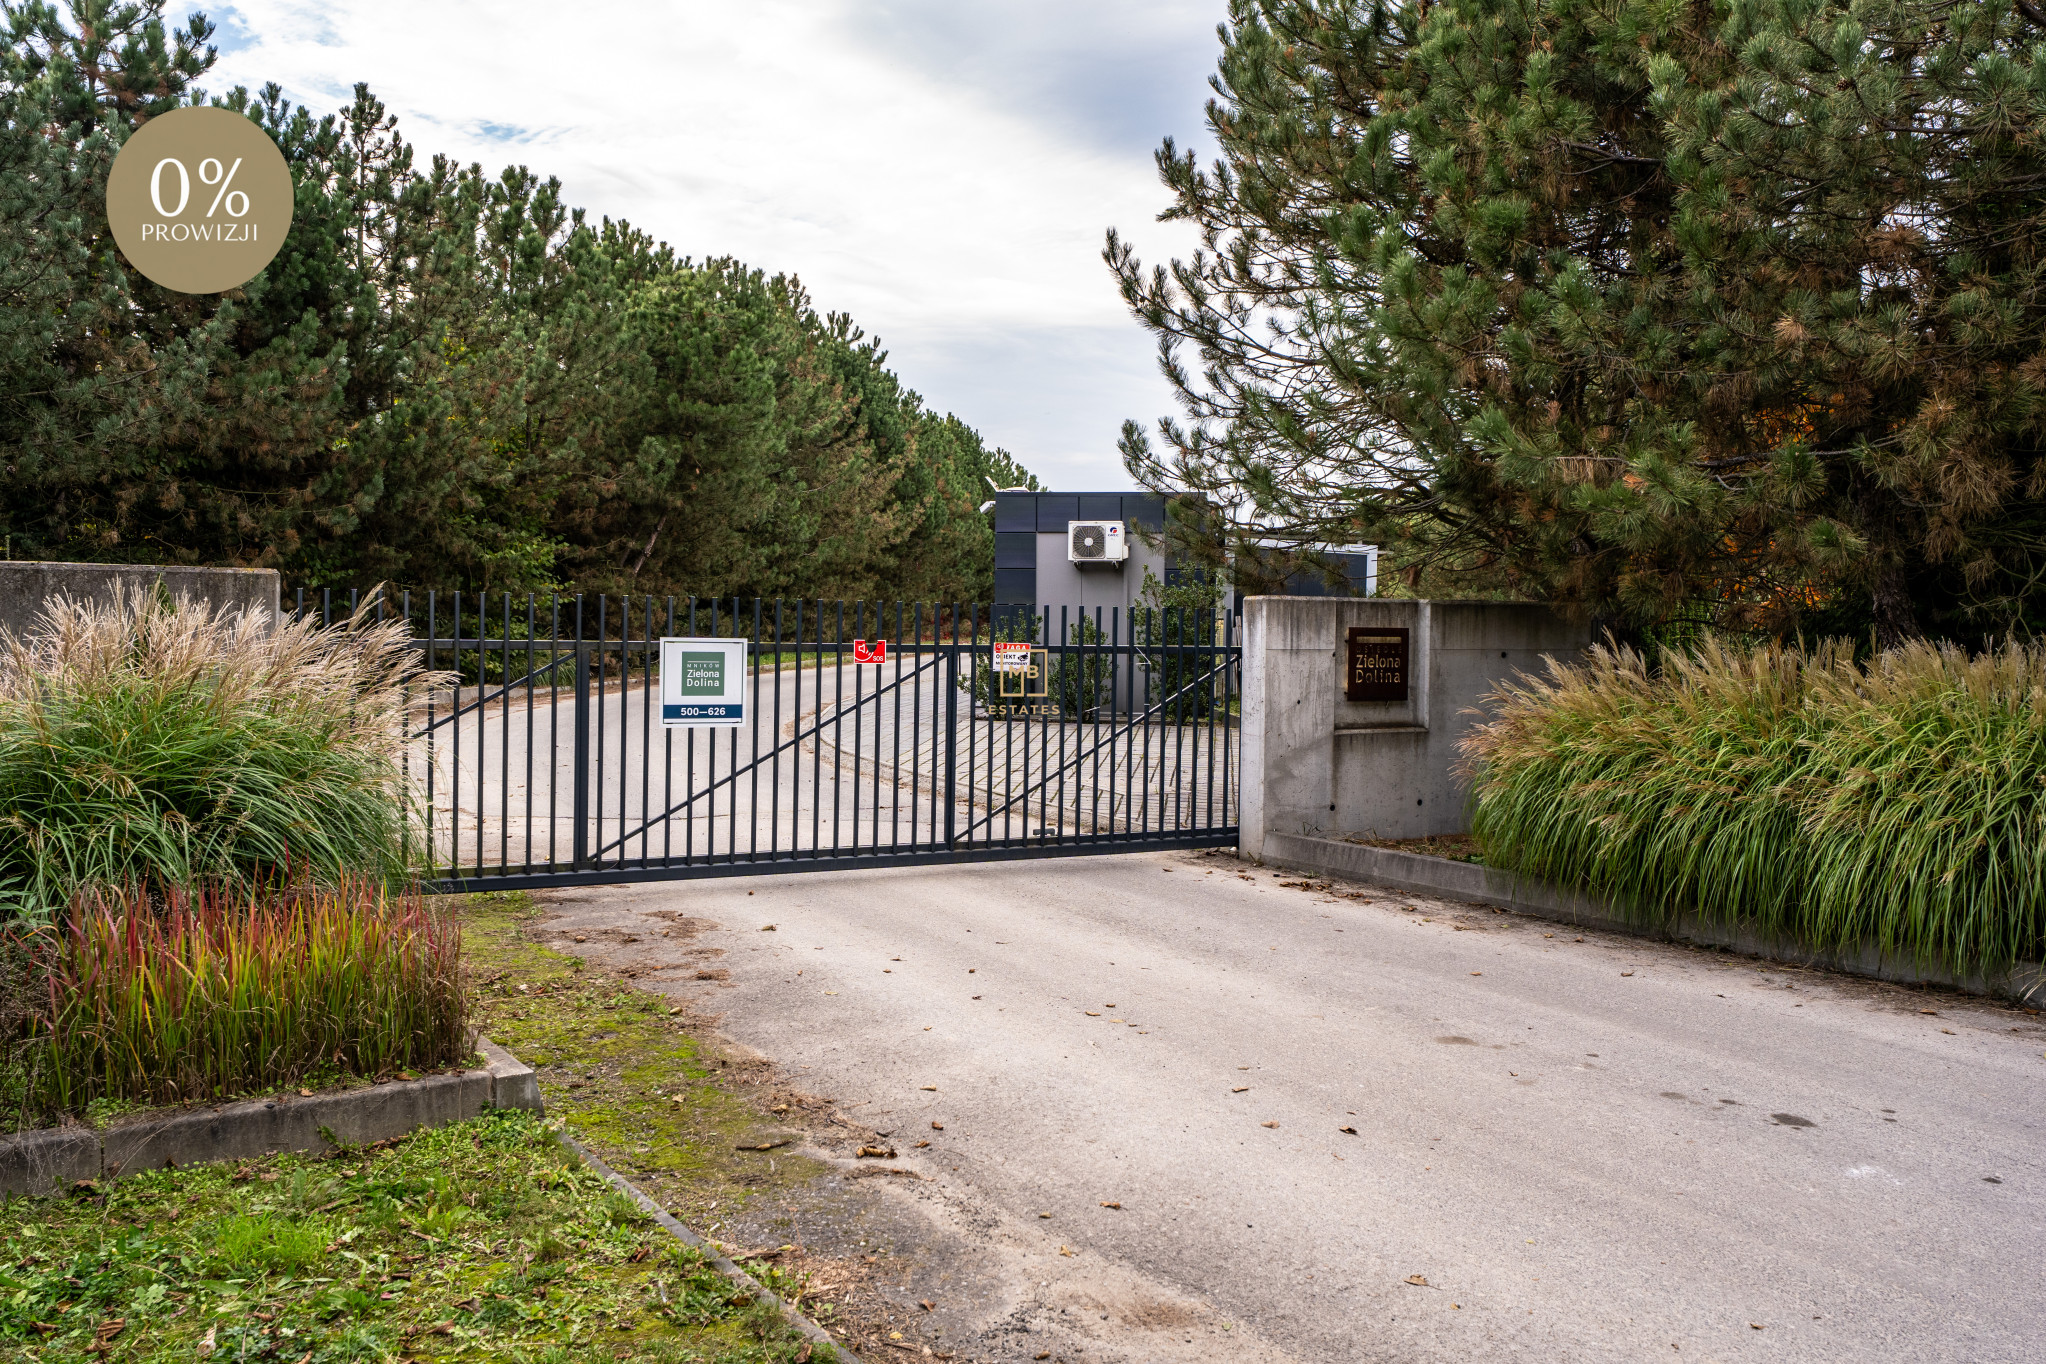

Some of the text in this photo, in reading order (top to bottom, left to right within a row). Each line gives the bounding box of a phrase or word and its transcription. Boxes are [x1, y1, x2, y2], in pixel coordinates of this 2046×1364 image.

[1355, 654, 1401, 668] Zielona
[687, 669, 720, 678] Zielona
[1355, 669, 1401, 683] Dolina
[686, 678, 720, 687] Dolina
